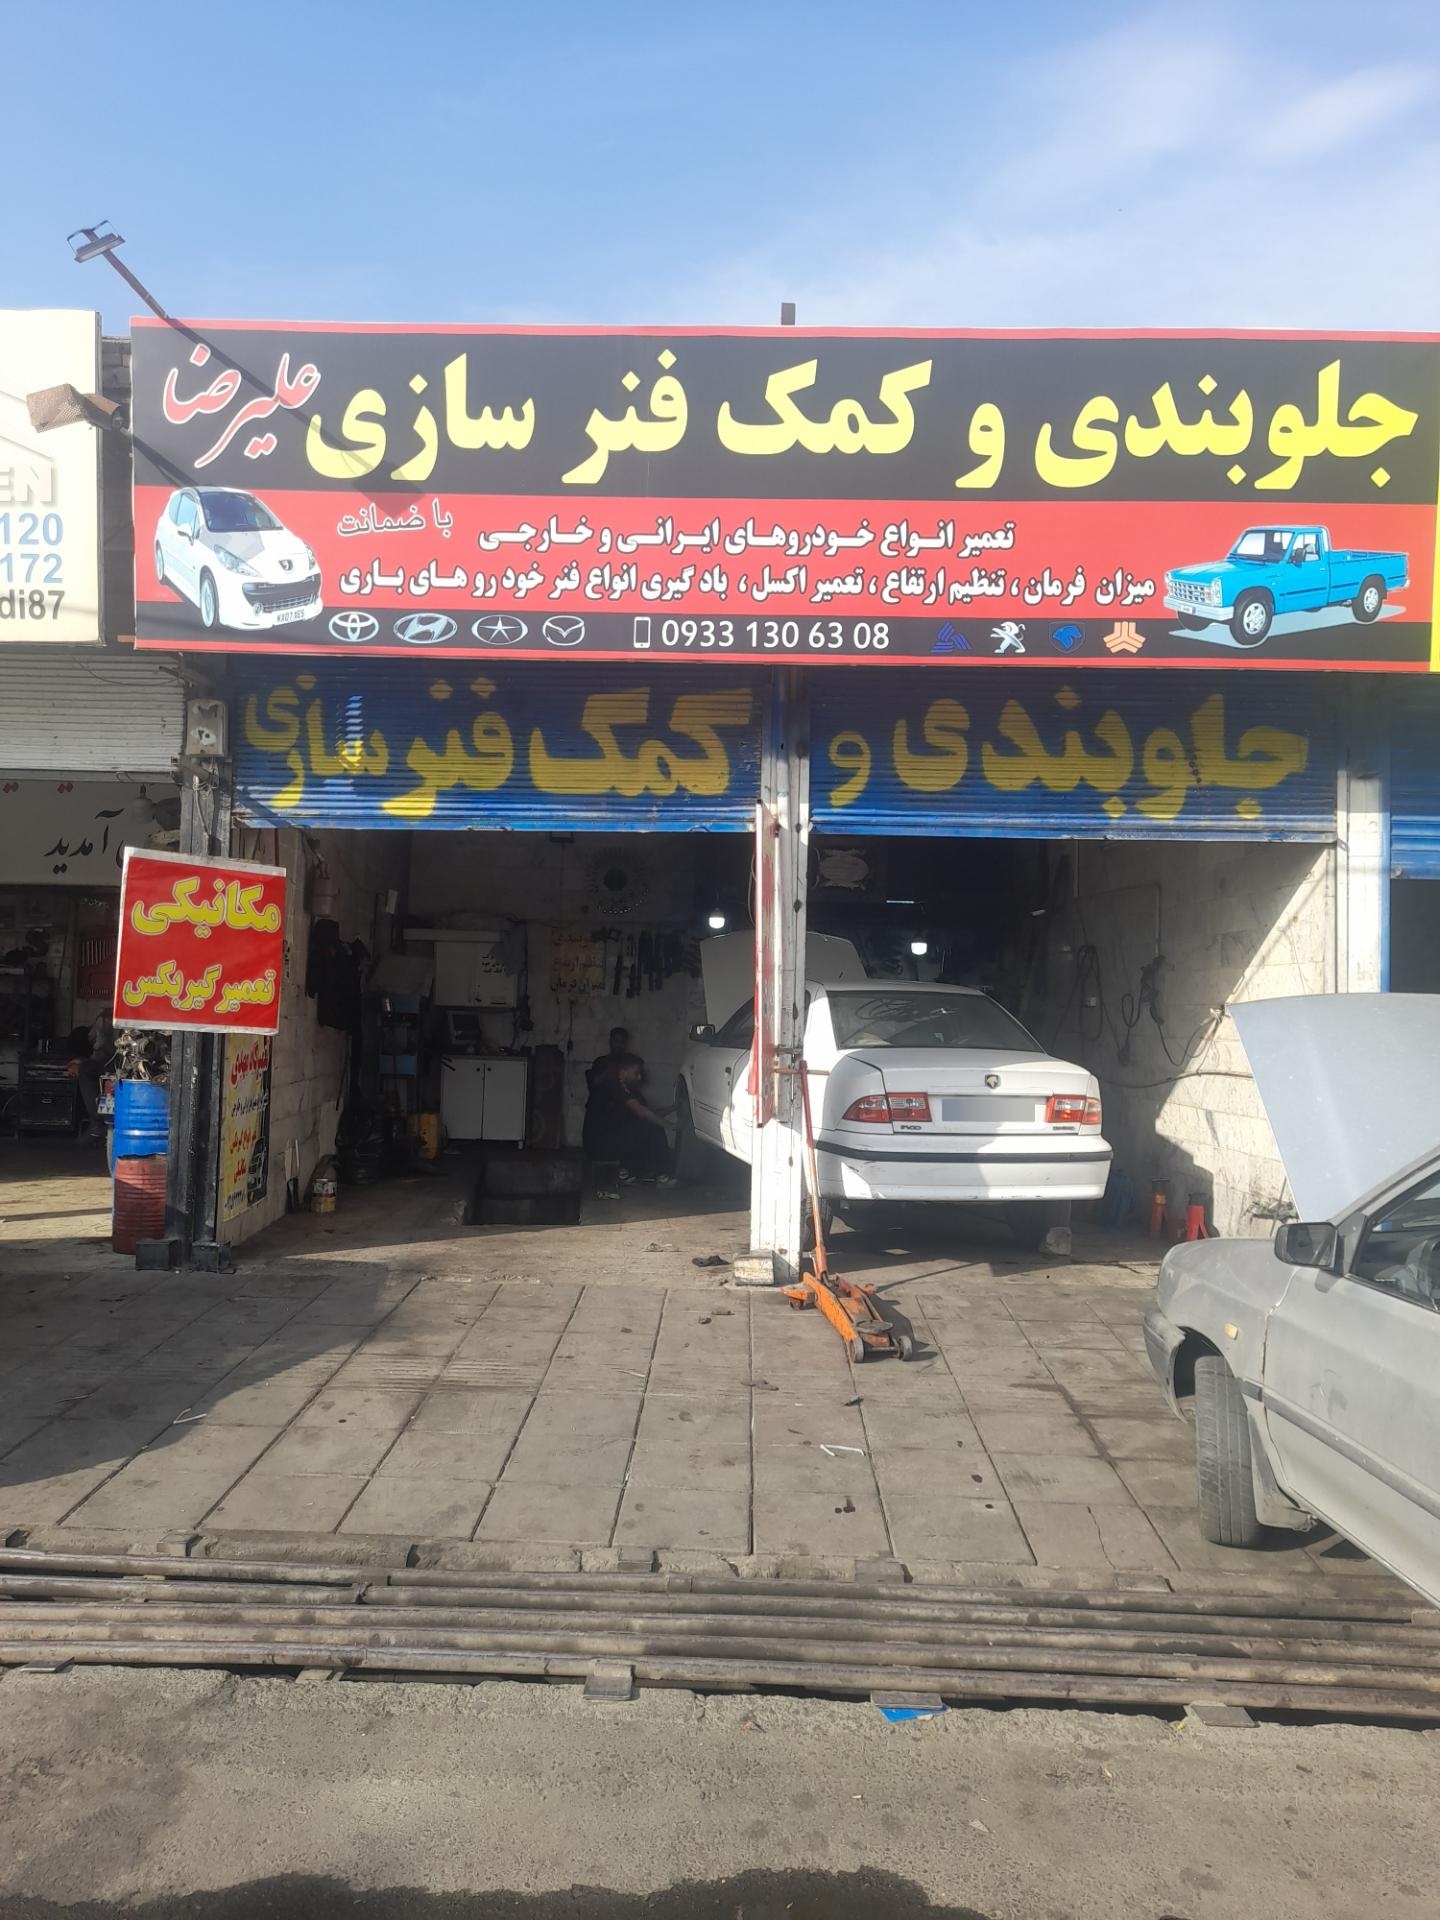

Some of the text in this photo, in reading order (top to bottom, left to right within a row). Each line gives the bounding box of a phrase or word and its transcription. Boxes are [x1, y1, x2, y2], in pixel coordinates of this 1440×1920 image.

[163, 343, 321, 468] علیرضا
[306, 349, 1420, 490] جلوبندی و کمک فنر سازی
[337, 498, 453, 538] با ضمانت
[478, 514, 594, 552] خارجی
[616, 516, 720, 554] ایرانی
[879, 518, 955, 558] انواع
[597, 526, 612, 553] و
[957, 520, 1016, 558] تعمیر
[340, 556, 405, 595] باری
[548, 560, 581, 600] فنر
[584, 561, 638, 601] انواع
[809, 567, 865, 604] تعمیر
[949, 566, 1008, 605] تنظیم
[1095, 567, 1156, 606] میزان
[661, 619, 890, 649] 0933 130 63 08
[245, 674, 755, 819] کمک فنر سازی
[828, 685, 1309, 821] جلوبندی و
[44, 807, 125, 874] آمدید
[132, 876, 281, 938] مکانیکی
[214, 969, 276, 1013] تعمیر
